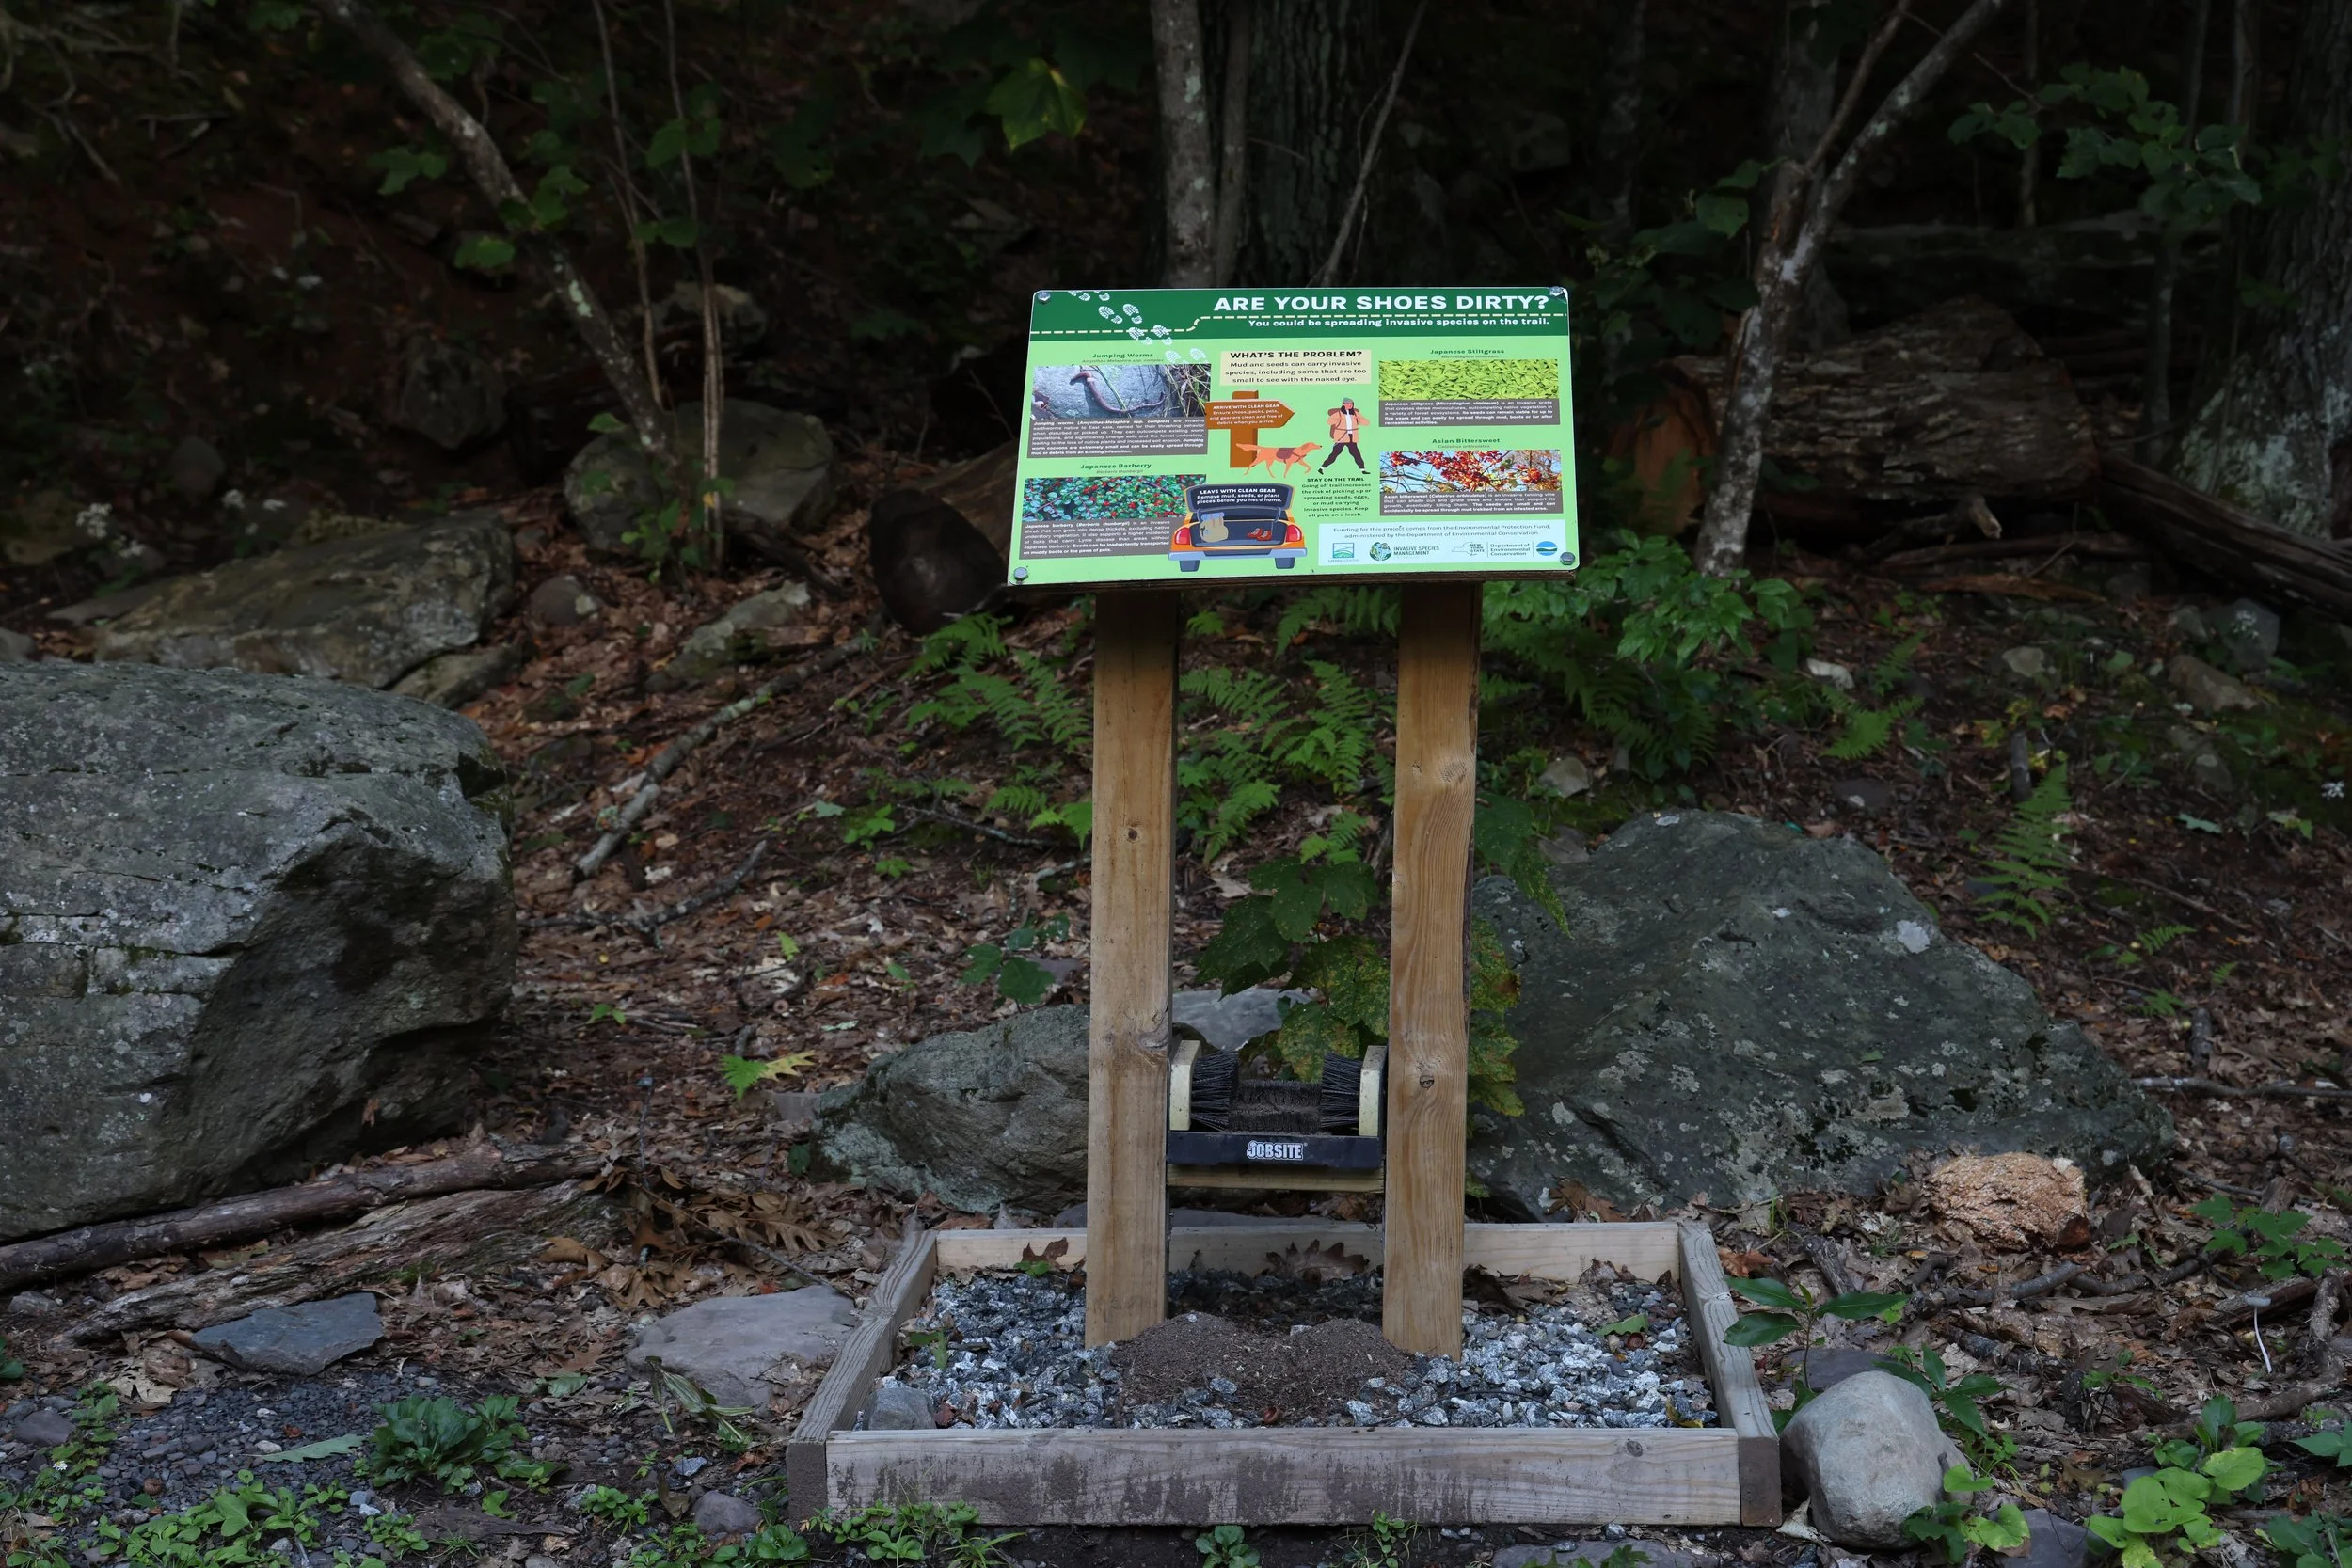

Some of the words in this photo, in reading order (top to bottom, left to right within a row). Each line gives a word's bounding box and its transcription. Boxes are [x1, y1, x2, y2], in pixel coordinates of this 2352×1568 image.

[1214, 297, 1264, 311] ARE
[1274, 296, 1347, 310] YOUR
[1357, 296, 1447, 309] SHOES
[1456, 295, 1549, 309] DIRTY?
[1325, 319, 1382, 327] spreading
[1247, 1140, 1304, 1161] JOBSITE
